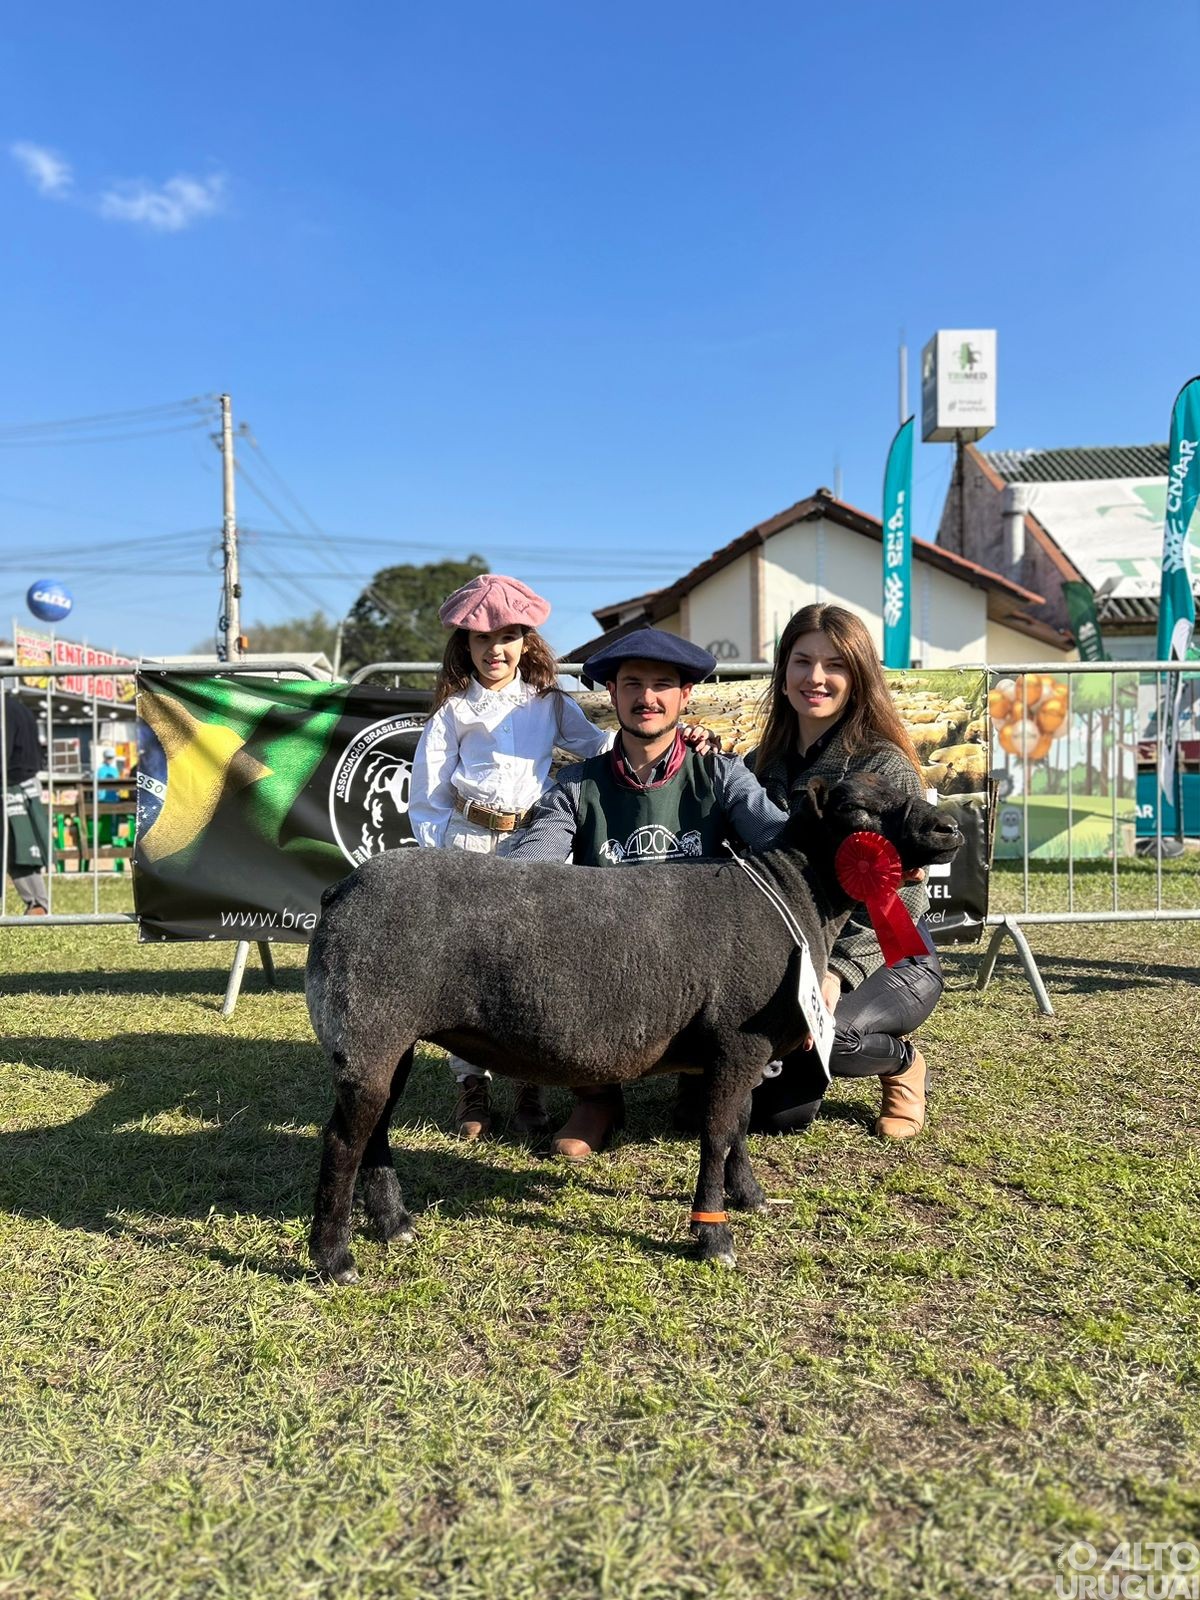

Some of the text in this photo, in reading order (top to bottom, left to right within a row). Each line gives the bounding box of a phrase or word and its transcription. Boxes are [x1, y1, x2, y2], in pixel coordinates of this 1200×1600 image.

[33, 591, 72, 610] CAIXA
[336, 742, 366, 798] ASSOCIAÇÃO
[220, 907, 317, 929] www.bra
[922, 909, 946, 924] xel
